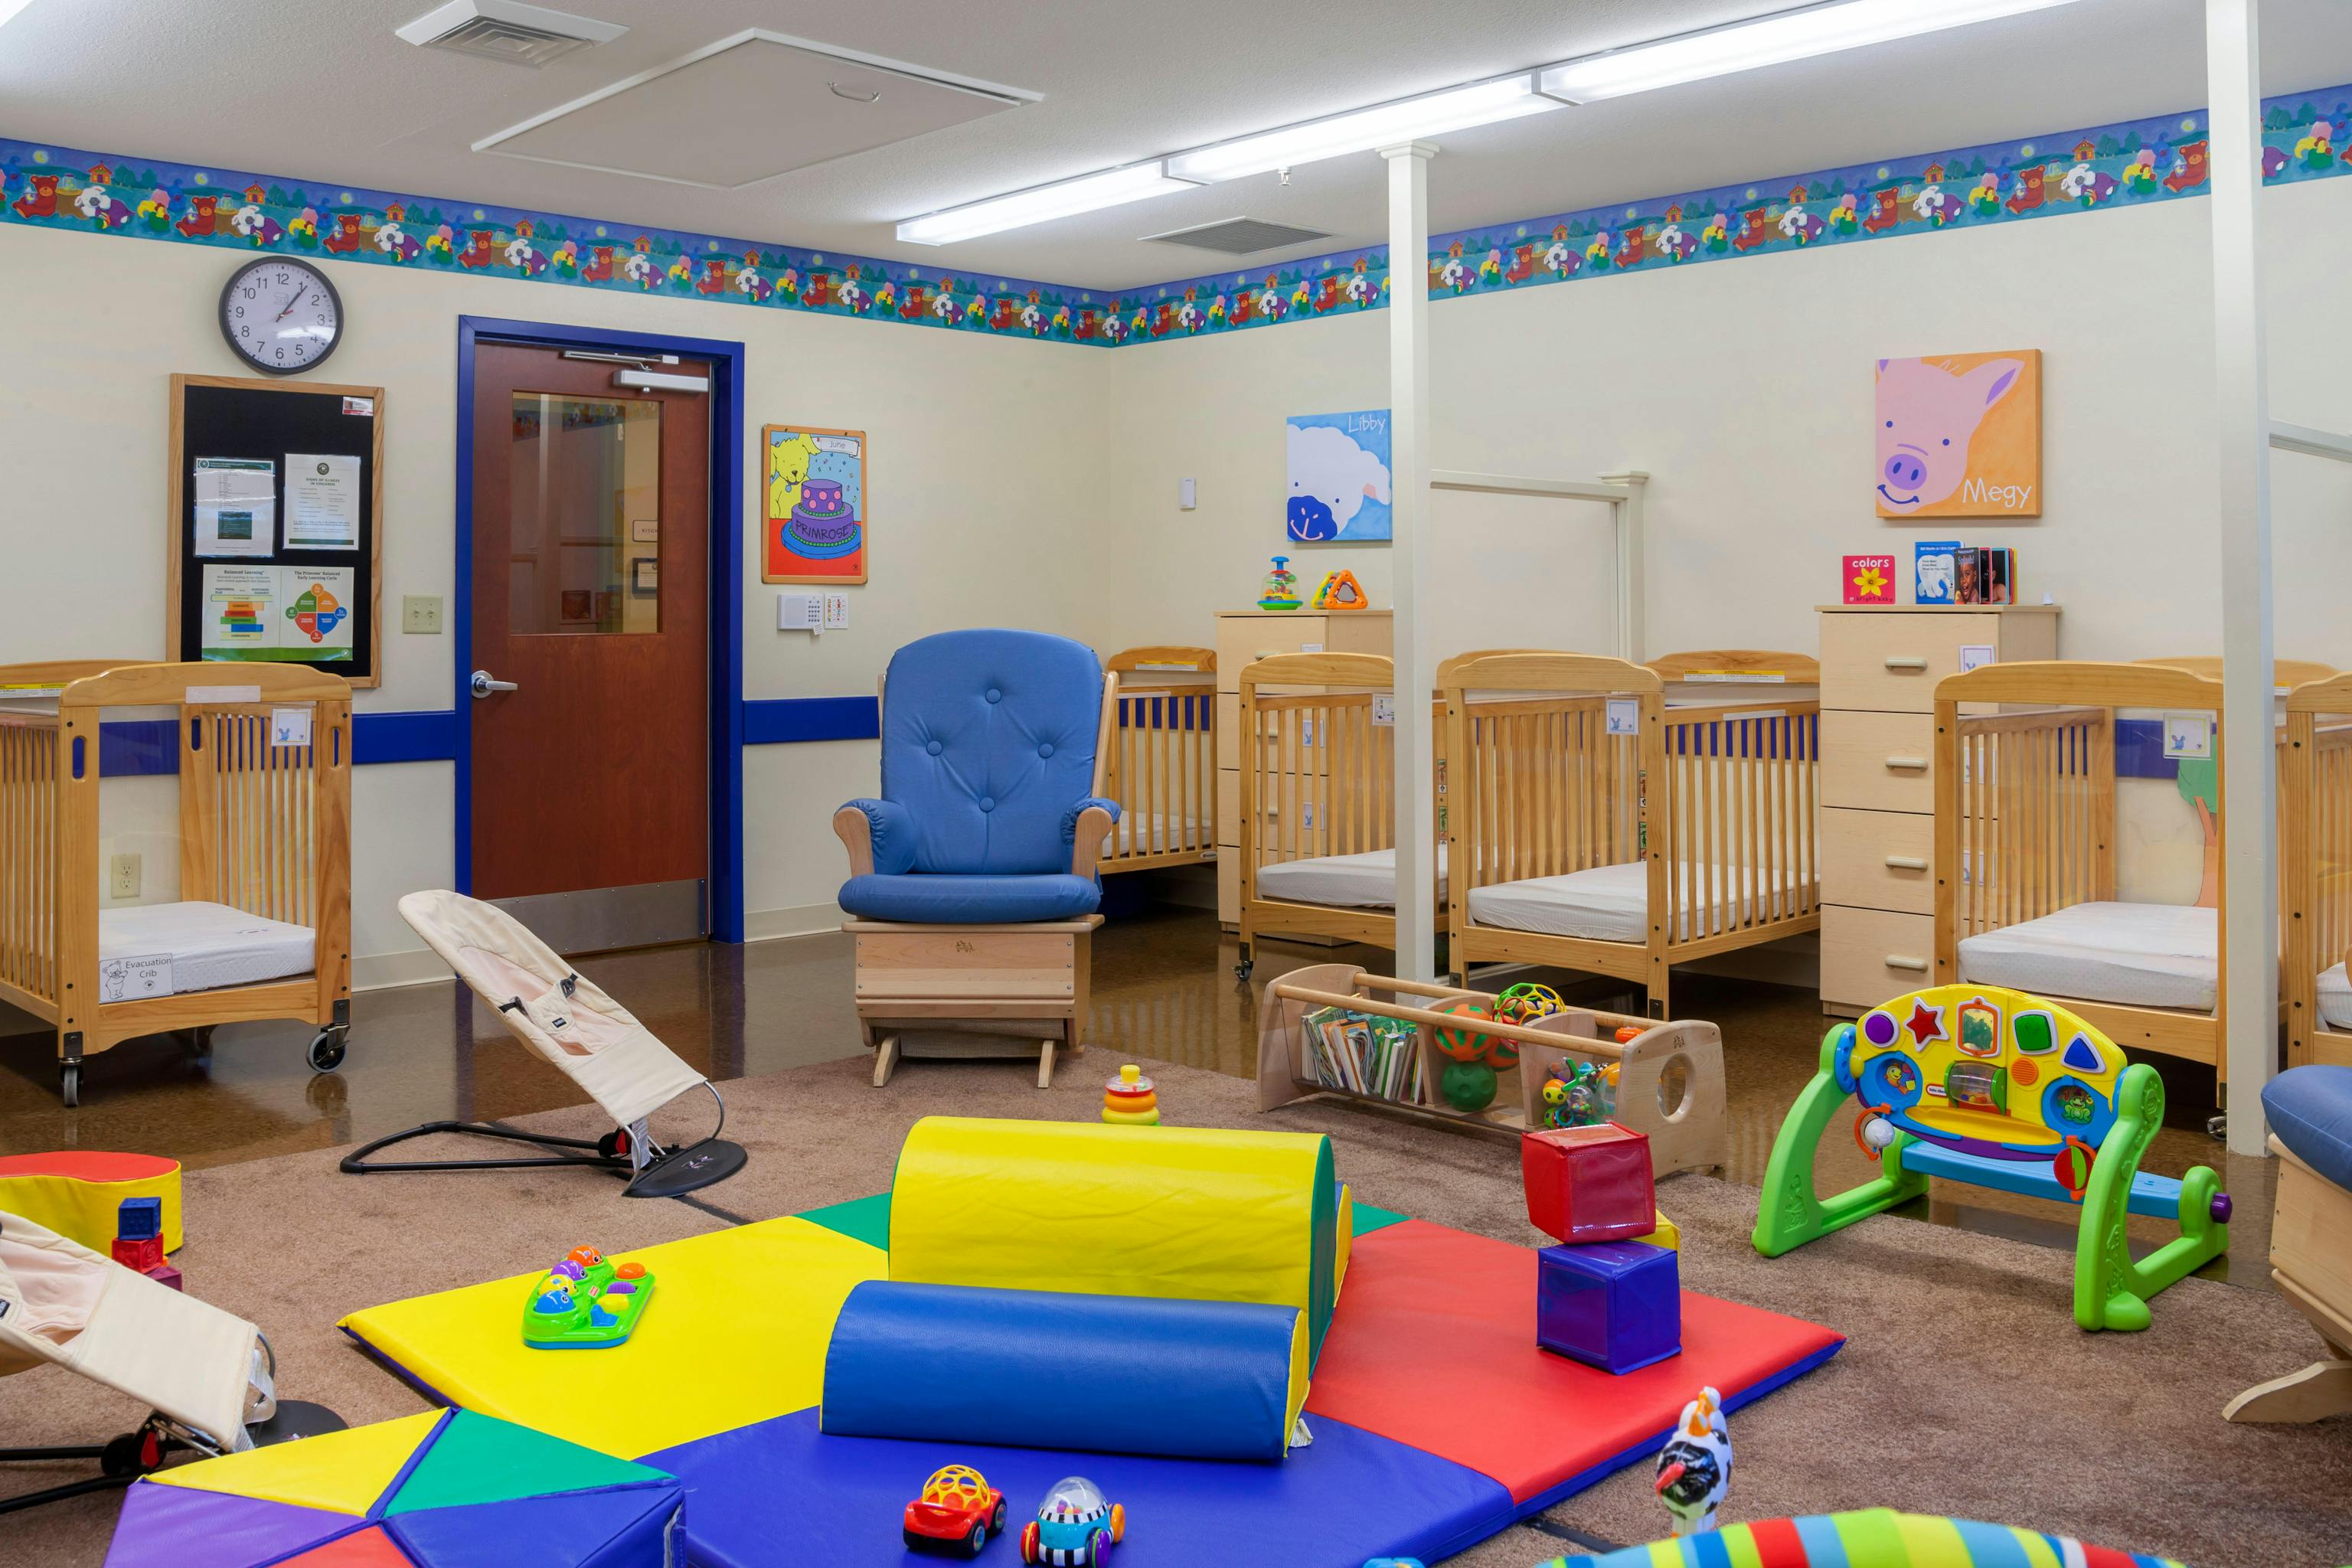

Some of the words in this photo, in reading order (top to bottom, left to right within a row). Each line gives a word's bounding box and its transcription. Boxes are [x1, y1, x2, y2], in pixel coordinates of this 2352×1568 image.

[256, 278, 268, 289] 11
[276, 273, 289, 285] 12
[299, 282, 304, 291] 1
[243, 288, 256, 299] 10
[312, 295, 320, 305] 2
[236, 306, 244, 318] 9
[317, 315, 325, 325] 3
[241, 325, 250, 337] 8
[256, 341, 266, 352] 7
[295, 345, 304, 355] 5
[276, 348, 284, 359] 6
[1348, 414, 1386, 435] Libby
[829, 440, 846, 449] June
[1962, 477, 2032, 508] Megy
[795, 520, 850, 540] PRIMROSE
[1852, 557, 1890, 567] colors
[126, 958, 172, 969] Evacuation
[139, 970, 157, 978] Crib
